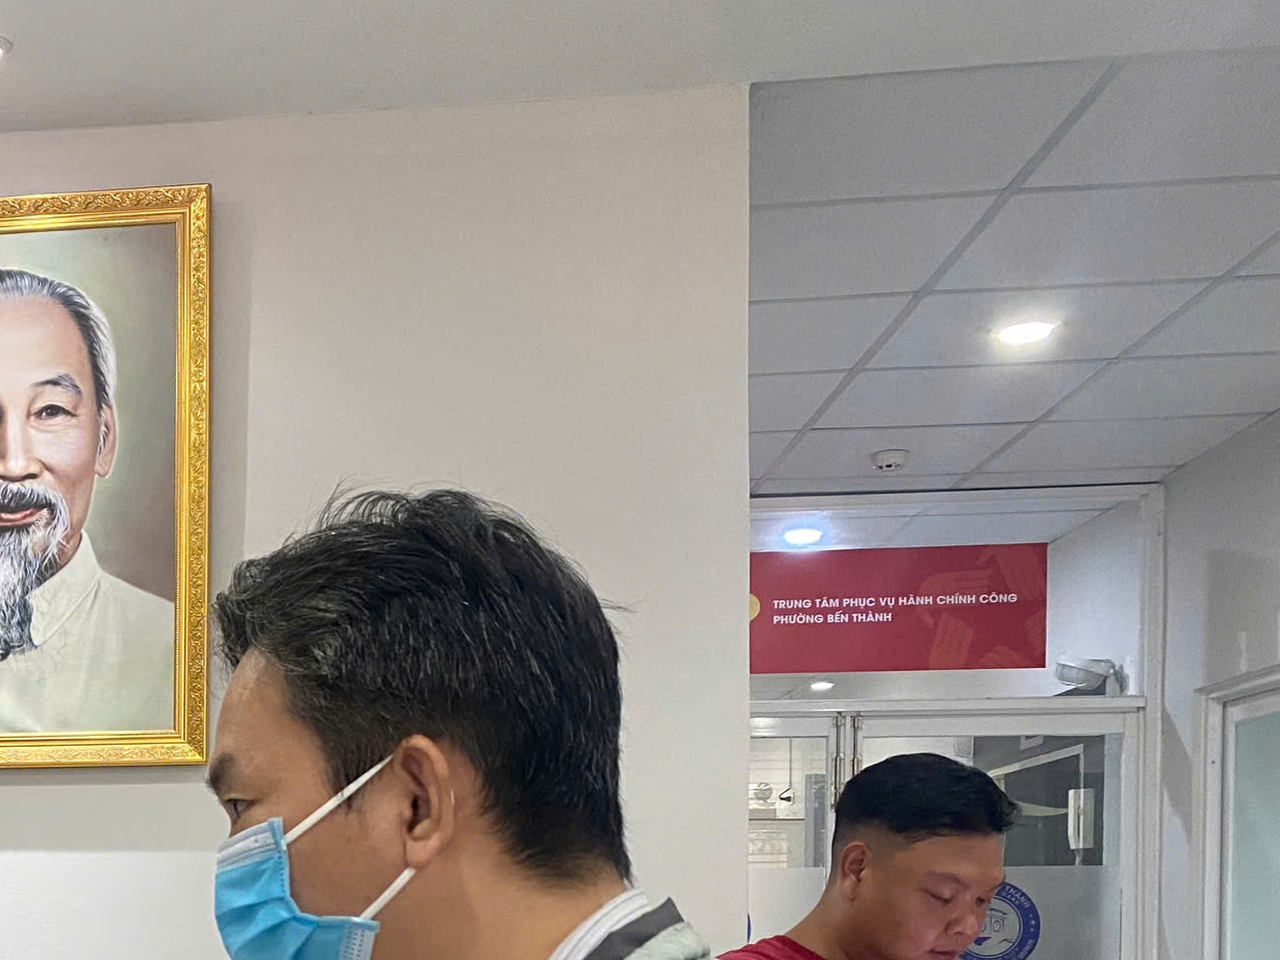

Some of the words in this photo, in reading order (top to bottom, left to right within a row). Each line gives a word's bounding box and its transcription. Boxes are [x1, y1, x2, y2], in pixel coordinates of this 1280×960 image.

[773, 599, 812, 609] TRUNG
[815, 596, 840, 608] TÂM
[842, 597, 876, 609] PHỤC
[878, 596, 895, 609] VỤ
[898, 594, 933, 606] HÀNH
[936, 592, 976, 605] CHÍNH
[979, 591, 1018, 604] CÔNG
[773, 612, 824, 625] PHƯỜNG
[827, 609, 849, 623] BẾN
[851, 610, 892, 623] THÀNH
